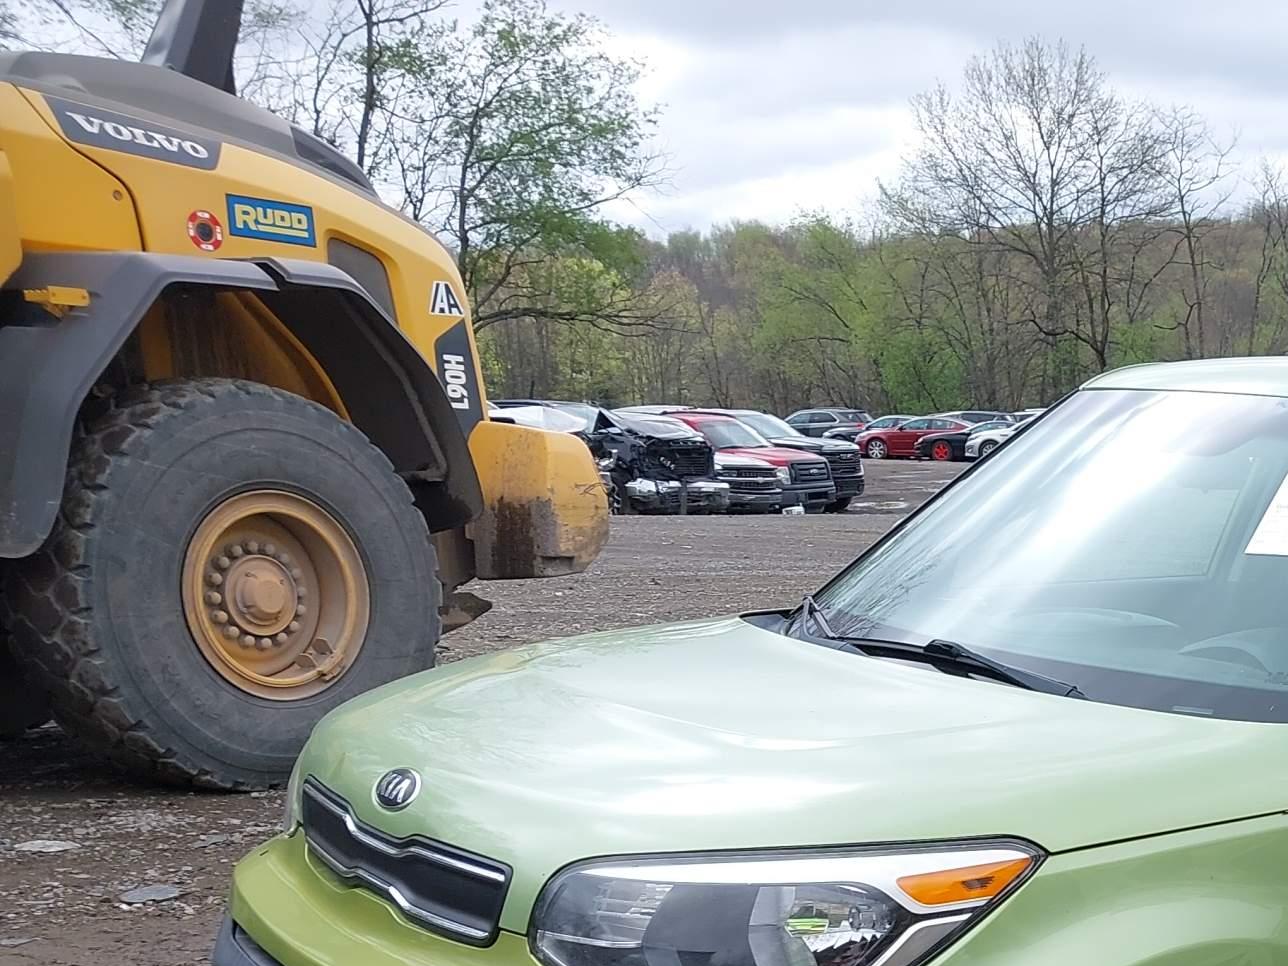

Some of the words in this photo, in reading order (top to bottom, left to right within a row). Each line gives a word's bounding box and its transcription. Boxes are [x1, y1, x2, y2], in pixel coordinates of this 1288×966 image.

[65, 112, 209, 159] VOLVO
[233, 203, 309, 231] RUDD
[442, 354, 470, 410] L90H
